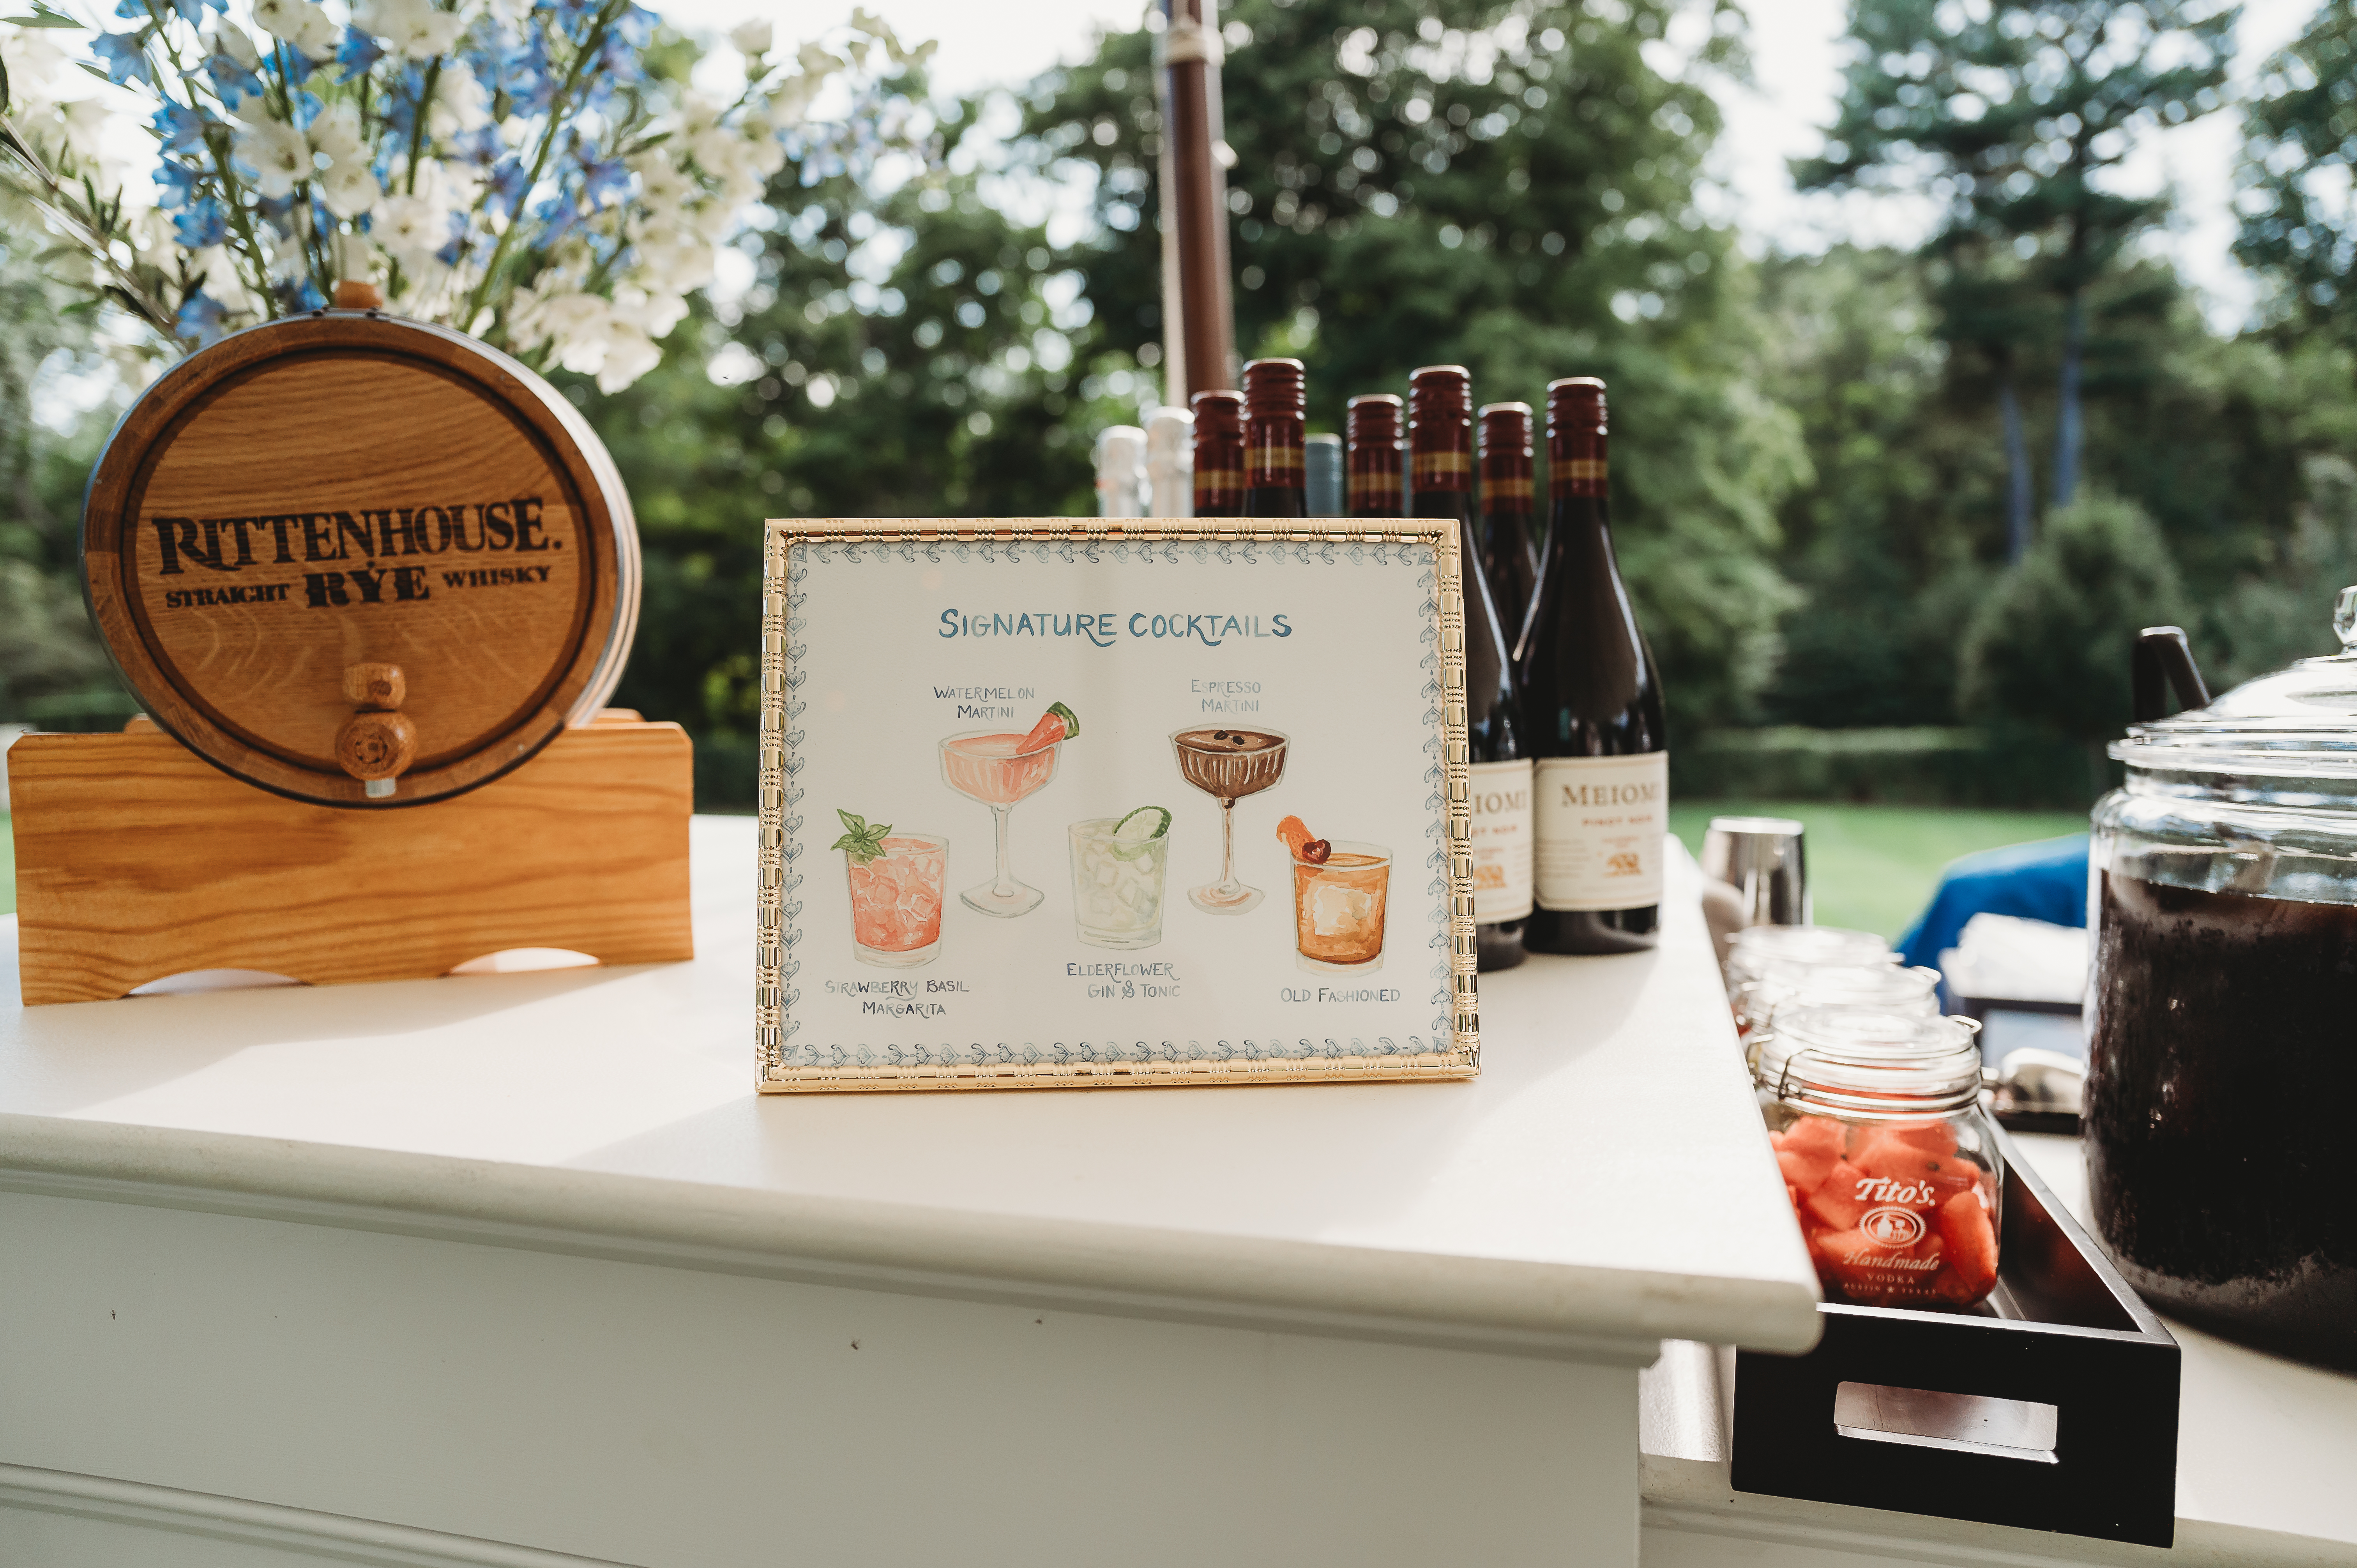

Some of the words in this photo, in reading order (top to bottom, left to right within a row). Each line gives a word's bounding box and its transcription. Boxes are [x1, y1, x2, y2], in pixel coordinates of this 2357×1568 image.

[165, 582, 291, 608] STRAIGHT
[302, 565, 431, 609] RYE
[442, 565, 551, 588] WHISKY
[939, 608, 1117, 647] SIGNATURE
[1129, 613, 1292, 647] COCKTAILS
[933, 686, 1034, 702] WATERMELON
[1191, 679, 1261, 697] ESPRESSO
[958, 705, 1014, 721] MARTINI
[1201, 698, 1259, 714] MARTINI
[1066, 963, 1180, 983] ELDERFLOWER
[825, 980, 918, 1001] STRAWBERRY
[926, 980, 970, 992] BASIL
[1087, 984, 1115, 998] GIN
[1122, 980, 1135, 999] &
[1140, 984, 1180, 998] TONIC
[1281, 987, 1311, 1002] OLD
[1318, 987, 1401, 1002] FASHIONED
[862, 1001, 946, 1019] MARGARITA
[1842, 1248, 1940, 1270] Handmade
[1867, 1272, 1915, 1285] VODKA
